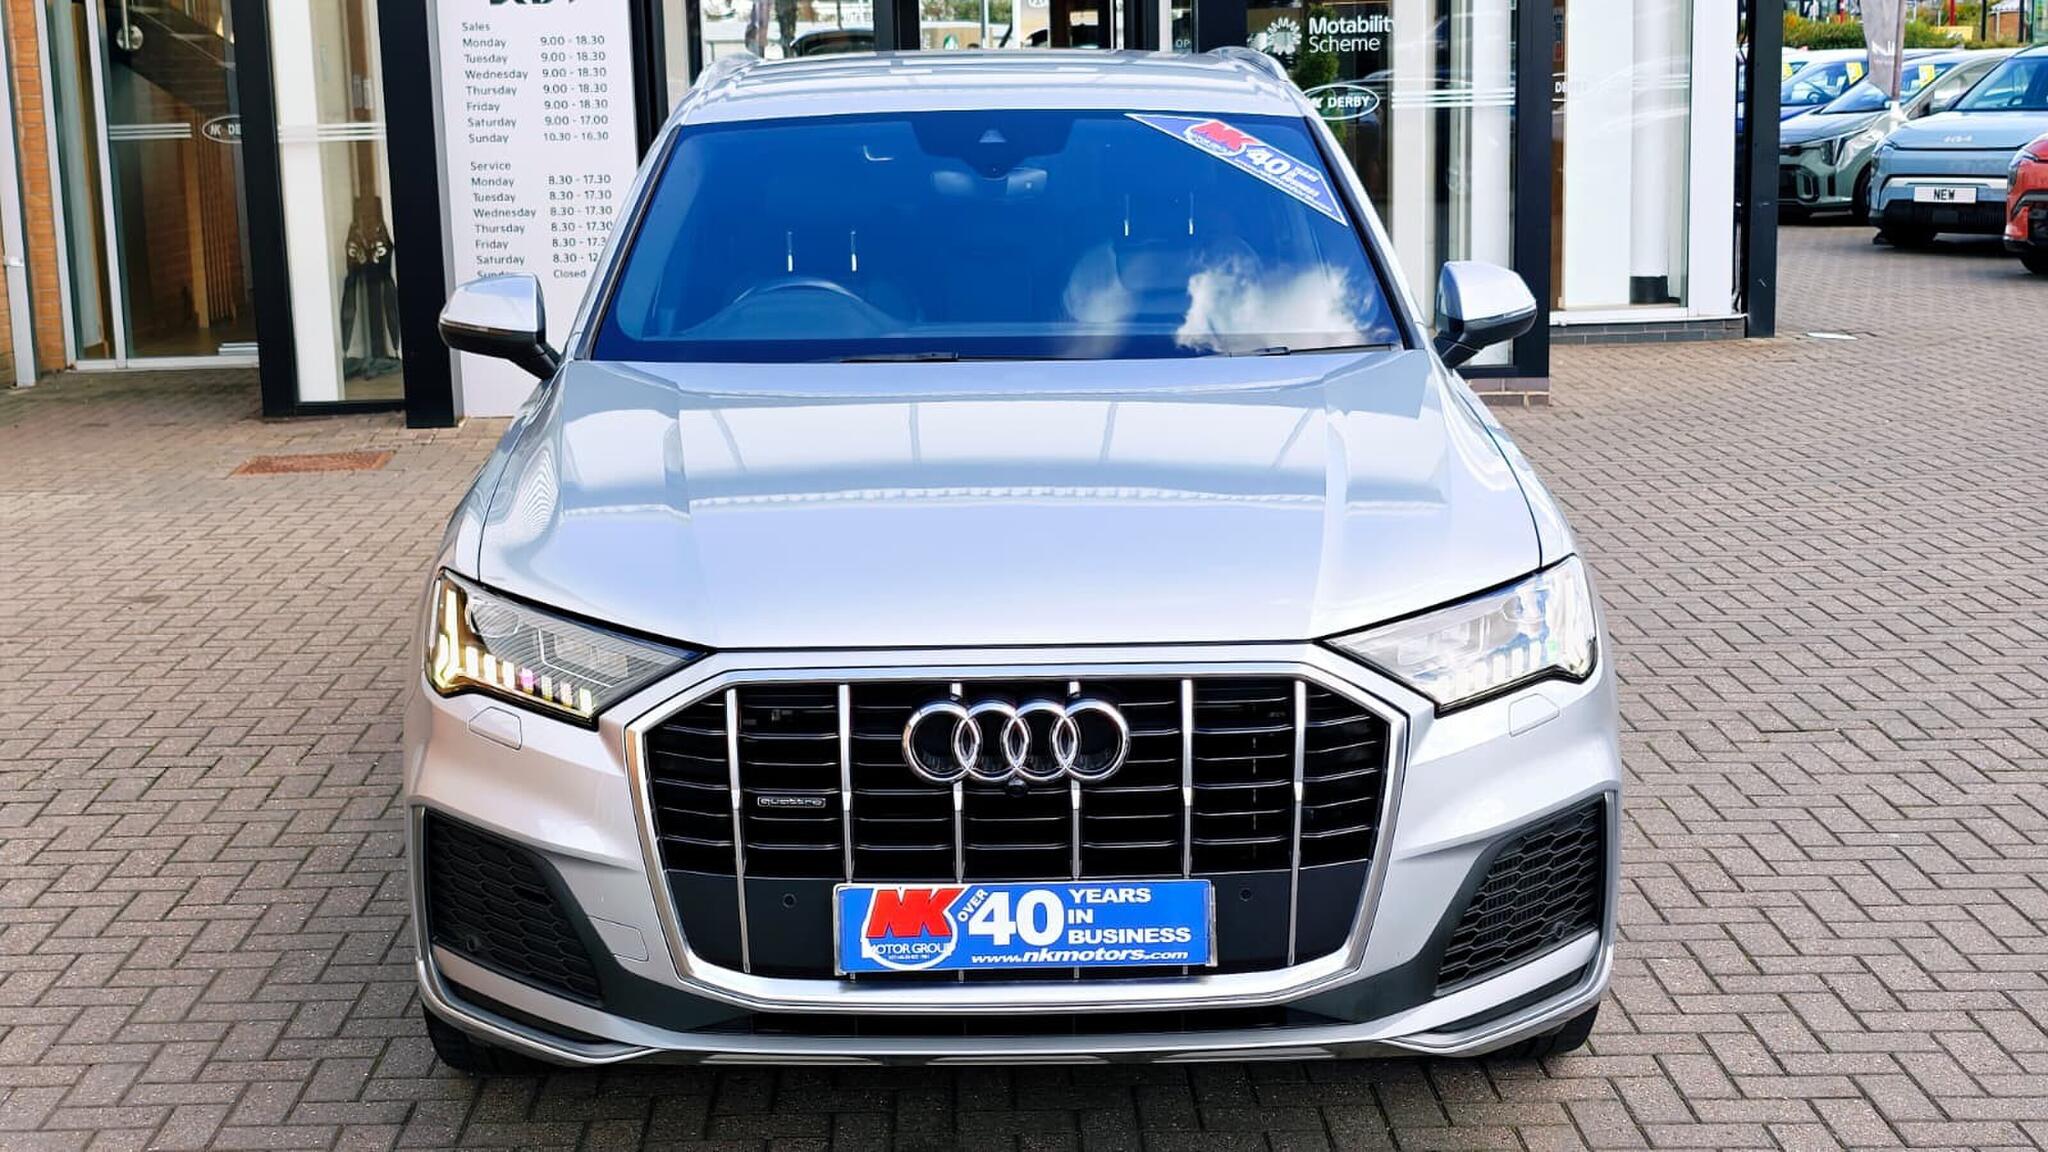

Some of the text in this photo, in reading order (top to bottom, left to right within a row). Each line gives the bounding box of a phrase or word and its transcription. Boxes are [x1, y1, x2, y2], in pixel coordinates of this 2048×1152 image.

[462, 22, 490, 31] Sales
[462, 38, 507, 49] Monday
[540, 36, 565, 46] 9.00
[576, 35, 605, 45] 18.30
[1309, 36, 1381, 52] Scheme
[464, 54, 508, 65] Tuesday
[541, 52, 566, 62] 9.00
[577, 51, 606, 61] 18.30
[465, 70, 529, 80] Wednesday
[542, 68, 567, 78] 9.00
[578, 67, 607, 77] 18.30
[466, 86, 518, 96] Thursday
[543, 84, 568, 94] 9.00
[579, 83, 608, 93] 18.30
[466, 102, 500, 112] Friday
[544, 100, 569, 110] 9.00
[580, 99, 609, 109] 18.30
[1327, 96, 1370, 108] DERBY
[467, 117, 517, 128] Saturday
[545, 115, 570, 126] 9.00
[580, 115, 609, 125] 17.00
[468, 134, 510, 144] Sunday
[544, 132, 571, 142] 10.30
[470, 161, 511, 171] Service
[1246, 149, 1291, 175] 40
[471, 177, 515, 187] Monday
[548, 175, 573, 185] 8.30
[584, 174, 612, 184] 17.30
[472, 192, 516, 203] Tuesday
[549, 191, 574, 200] 8.30
[585, 190, 613, 199] 17.30
[1934, 189, 1956, 200] NEW
[473, 208, 537, 219] Wednesday
[550, 206, 575, 216] 8.30
[585, 205, 613, 215] 17.30
[474, 224, 526, 235] Thursday
[551, 222, 576, 232] 8.30
[586, 221, 613, 231] 17.30
[475, 240, 509, 250] Friday
[552, 238, 576, 247] 8.30
[476, 255, 526, 266] Saturday
[553, 253, 577, 263] 8.30
[553, 269, 587, 279] Closed
[760, 798, 823, 806] quattro
[1068, 888, 1152, 904] YEARS
[957, 889, 990, 922] OVER
[866, 888, 965, 938] NK
[968, 889, 1065, 946] 40
[1068, 909, 1093, 924] IN
[1068, 927, 1192, 945] BUSINESS
[971, 948, 1189, 964] www.nkmotors.com
